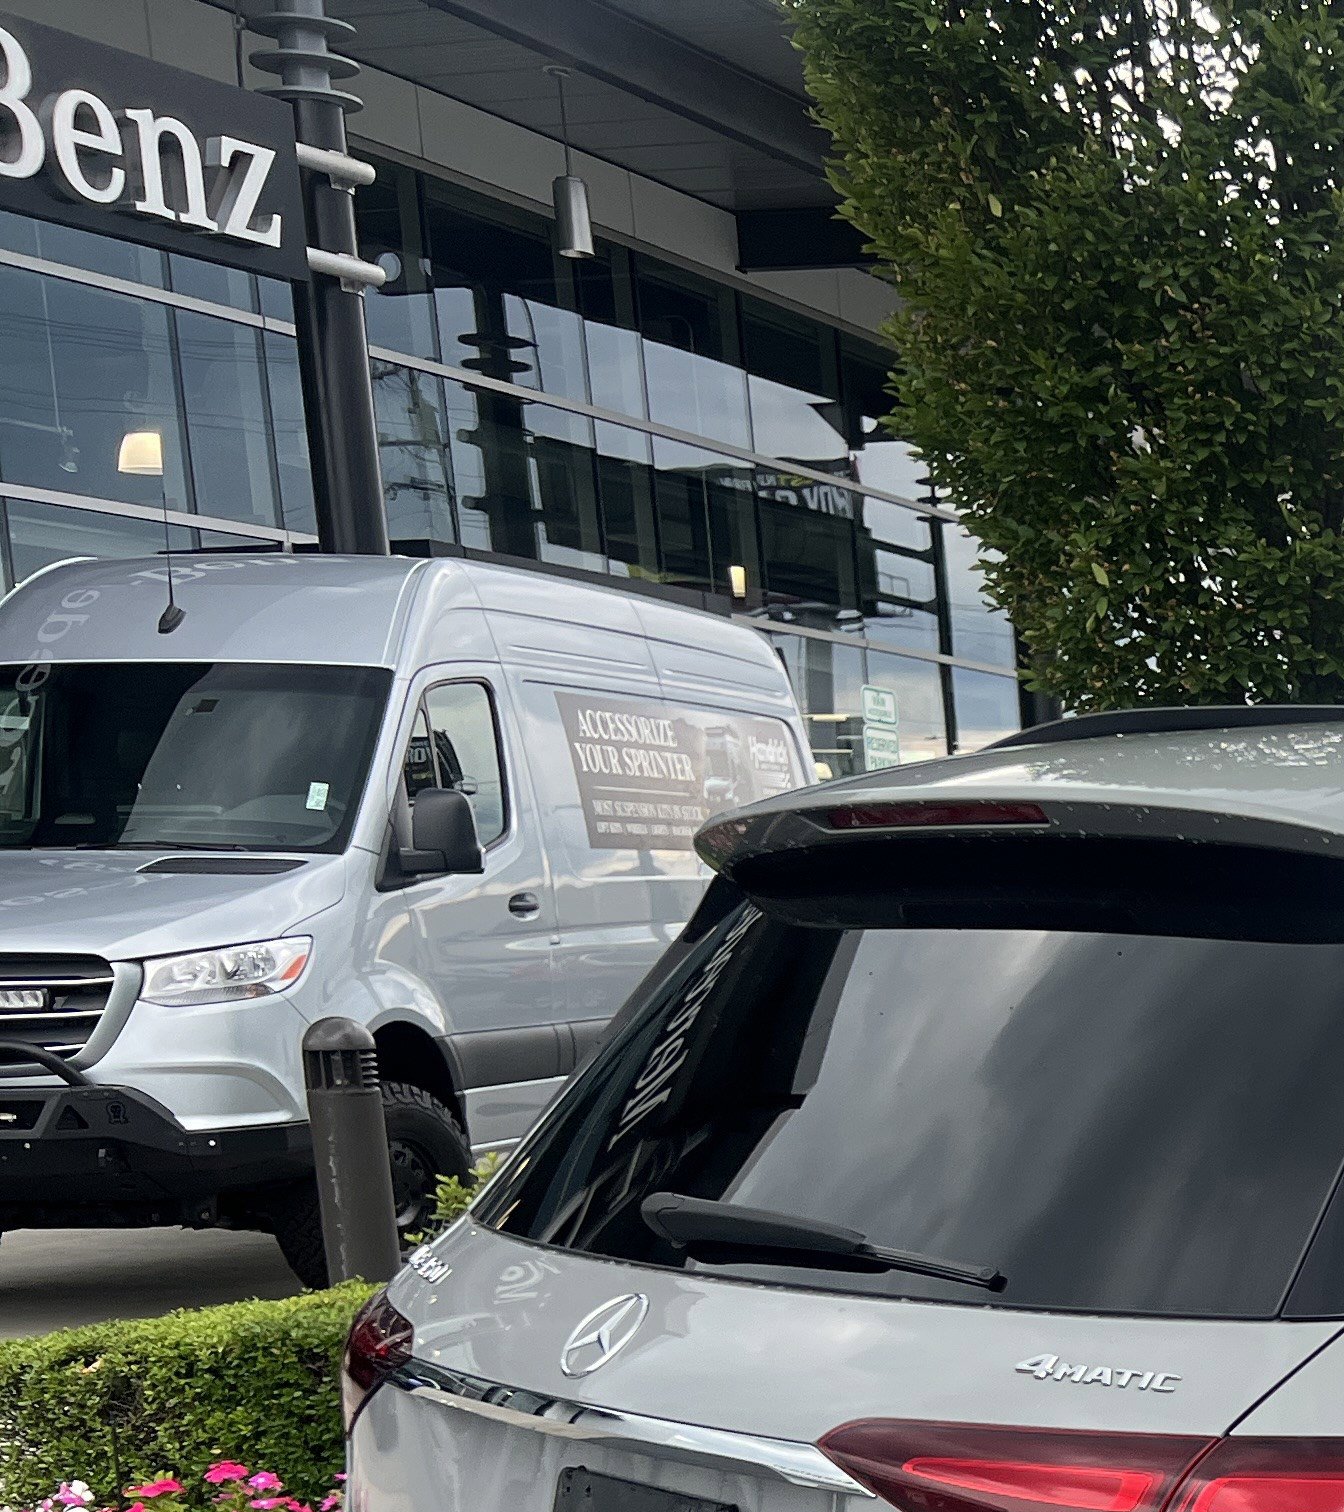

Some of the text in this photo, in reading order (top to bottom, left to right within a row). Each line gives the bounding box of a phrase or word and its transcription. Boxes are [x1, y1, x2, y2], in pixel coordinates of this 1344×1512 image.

[0, 26, 282, 248] Benz
[577, 709, 678, 748] ACCESSORIZE
[574, 742, 697, 782] YOUR SPRINTER
[1015, 1353, 1182, 1393] 4MATIC
